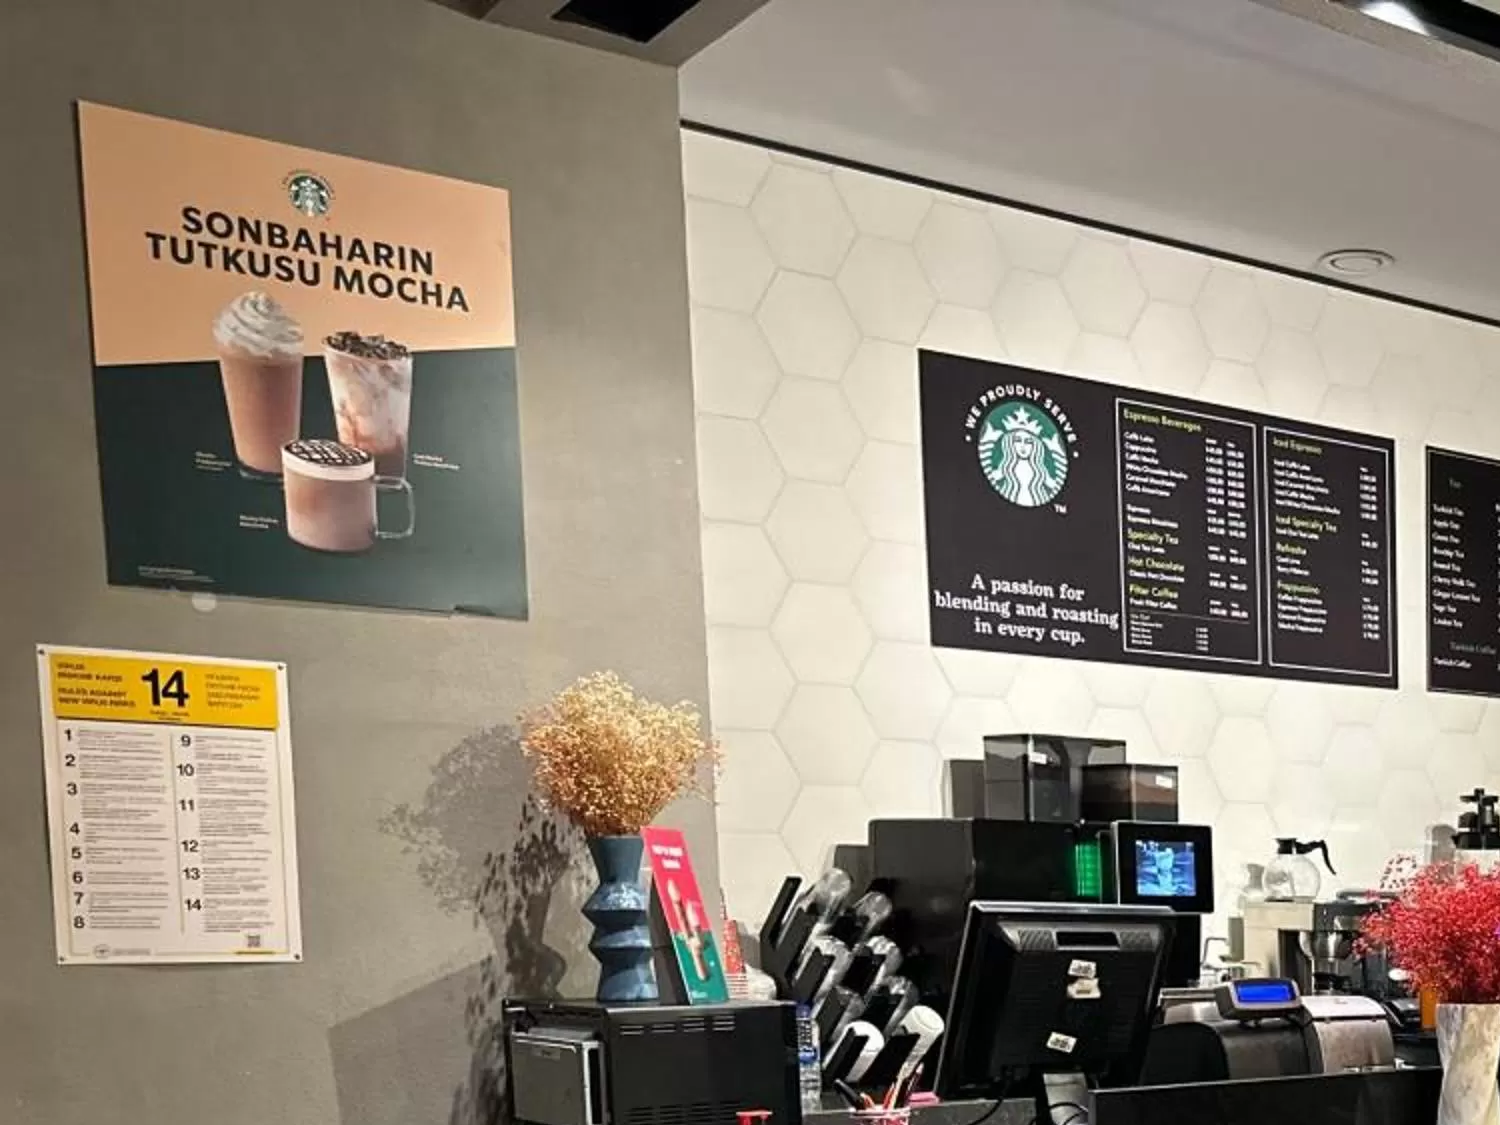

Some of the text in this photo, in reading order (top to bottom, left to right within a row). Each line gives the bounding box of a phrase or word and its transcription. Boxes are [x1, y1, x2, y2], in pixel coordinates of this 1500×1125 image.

[181, 206, 434, 276] SONBAHARIN
[145, 231, 469, 312] TUTKUSU MOCHA
[965, 384, 1077, 443] WE PROUDLY SERVE
[1145, 557, 1184, 573] Chocolate
[971, 573, 1085, 601] A passion for
[1151, 587, 1178, 599] Coffee
[934, 589, 1011, 618] blending
[1015, 602, 1047, 619] and
[1052, 607, 1119, 630] roasting
[974, 617, 1085, 646] in every cup.
[141, 667, 190, 708] 14
[64, 728, 71, 741] 1
[181, 735, 191, 747] 9
[65, 754, 76, 767] 2
[177, 764, 194, 777] 10
[67, 782, 78, 796] 3
[179, 799, 194, 812] 11
[69, 822, 80, 835] 4
[71, 847, 81, 859] 5
[181, 840, 198, 853] 12
[73, 872, 83, 884] 6
[183, 868, 200, 880] 13
[74, 893, 83, 905] 7
[185, 899, 202, 911] 14
[74, 917, 85, 929] 8
